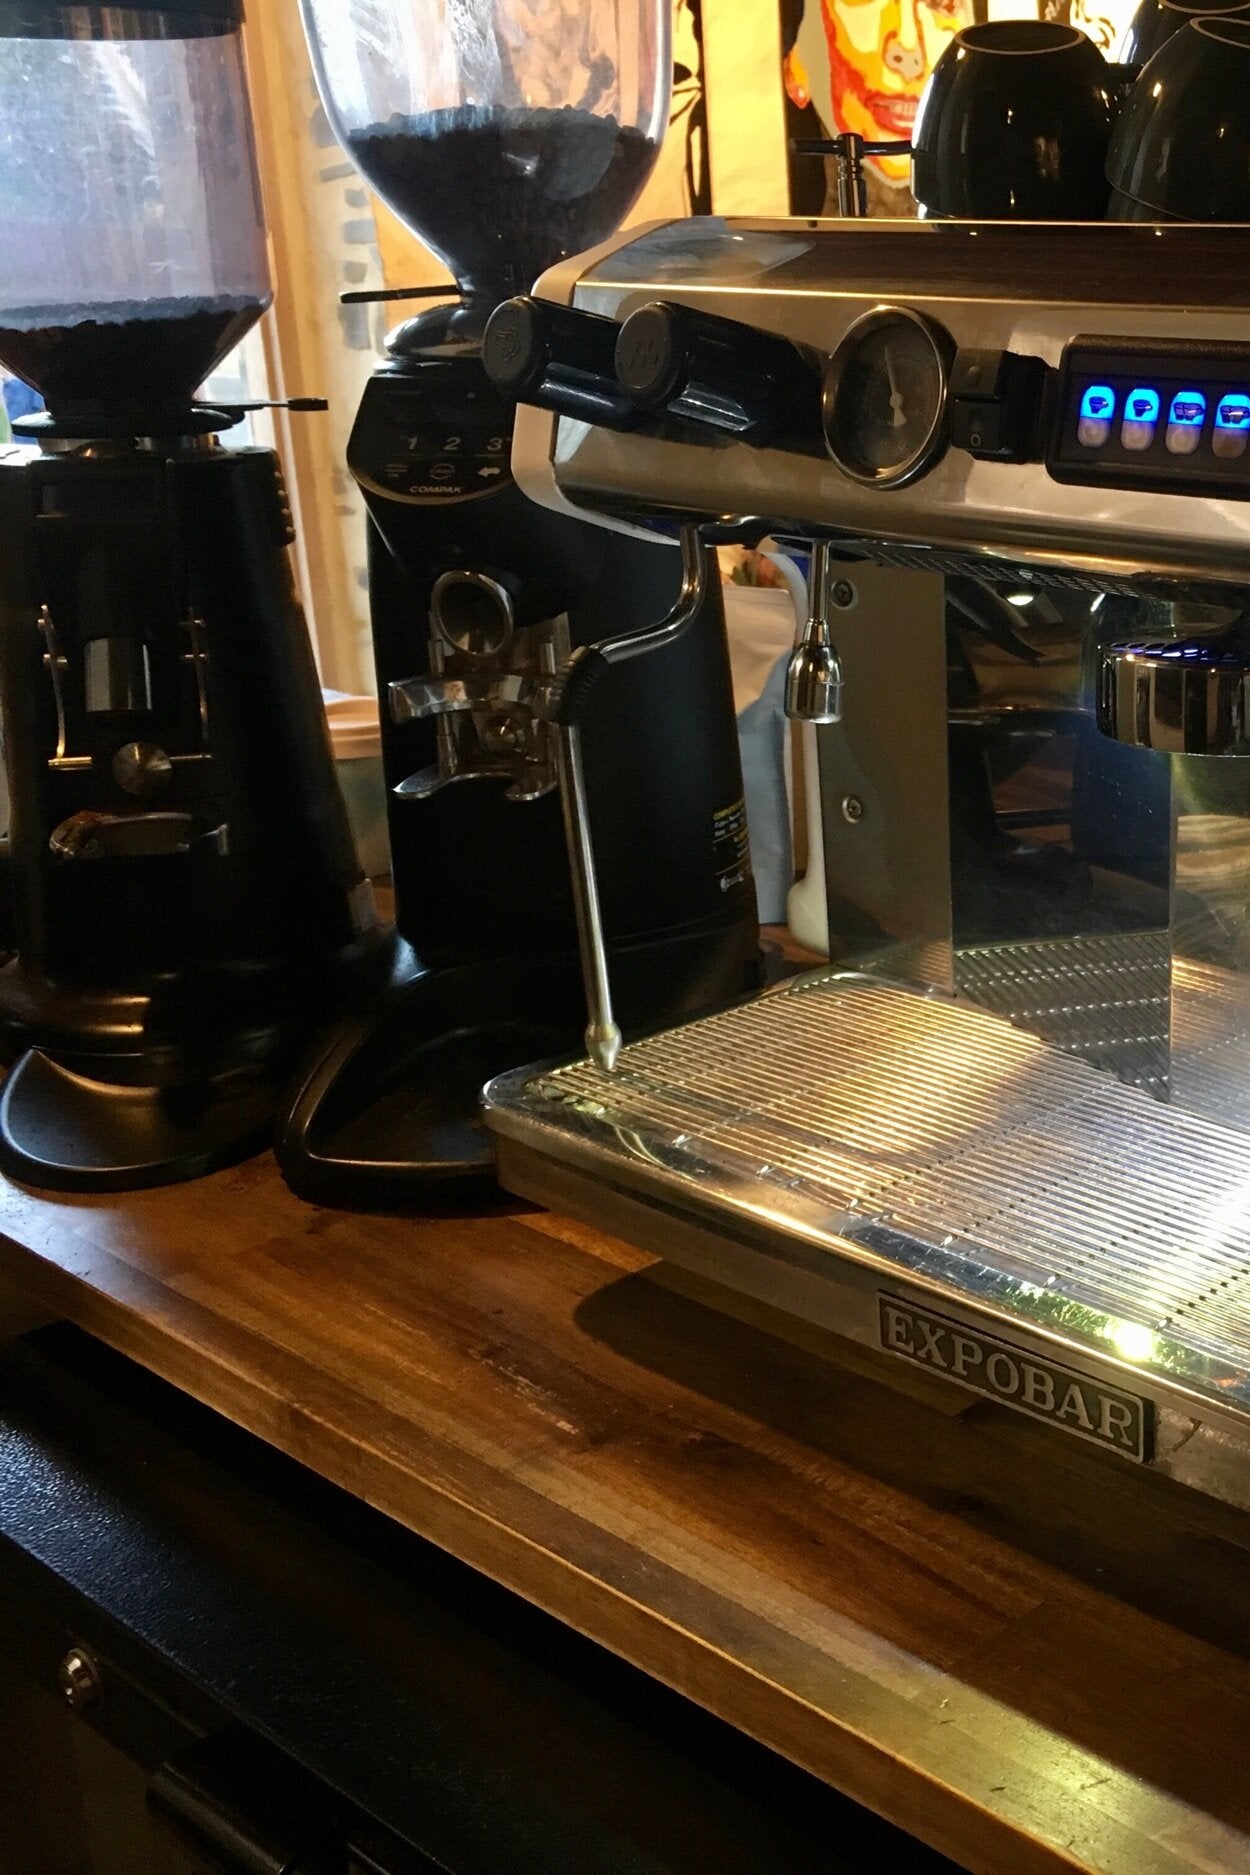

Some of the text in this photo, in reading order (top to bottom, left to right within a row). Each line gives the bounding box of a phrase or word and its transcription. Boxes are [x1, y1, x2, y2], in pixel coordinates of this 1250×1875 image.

[406, 436, 503, 451] 1 2 3
[409, 484, 462, 494] COMPAK
[884, 1305, 1133, 1447] EXPOBAR
